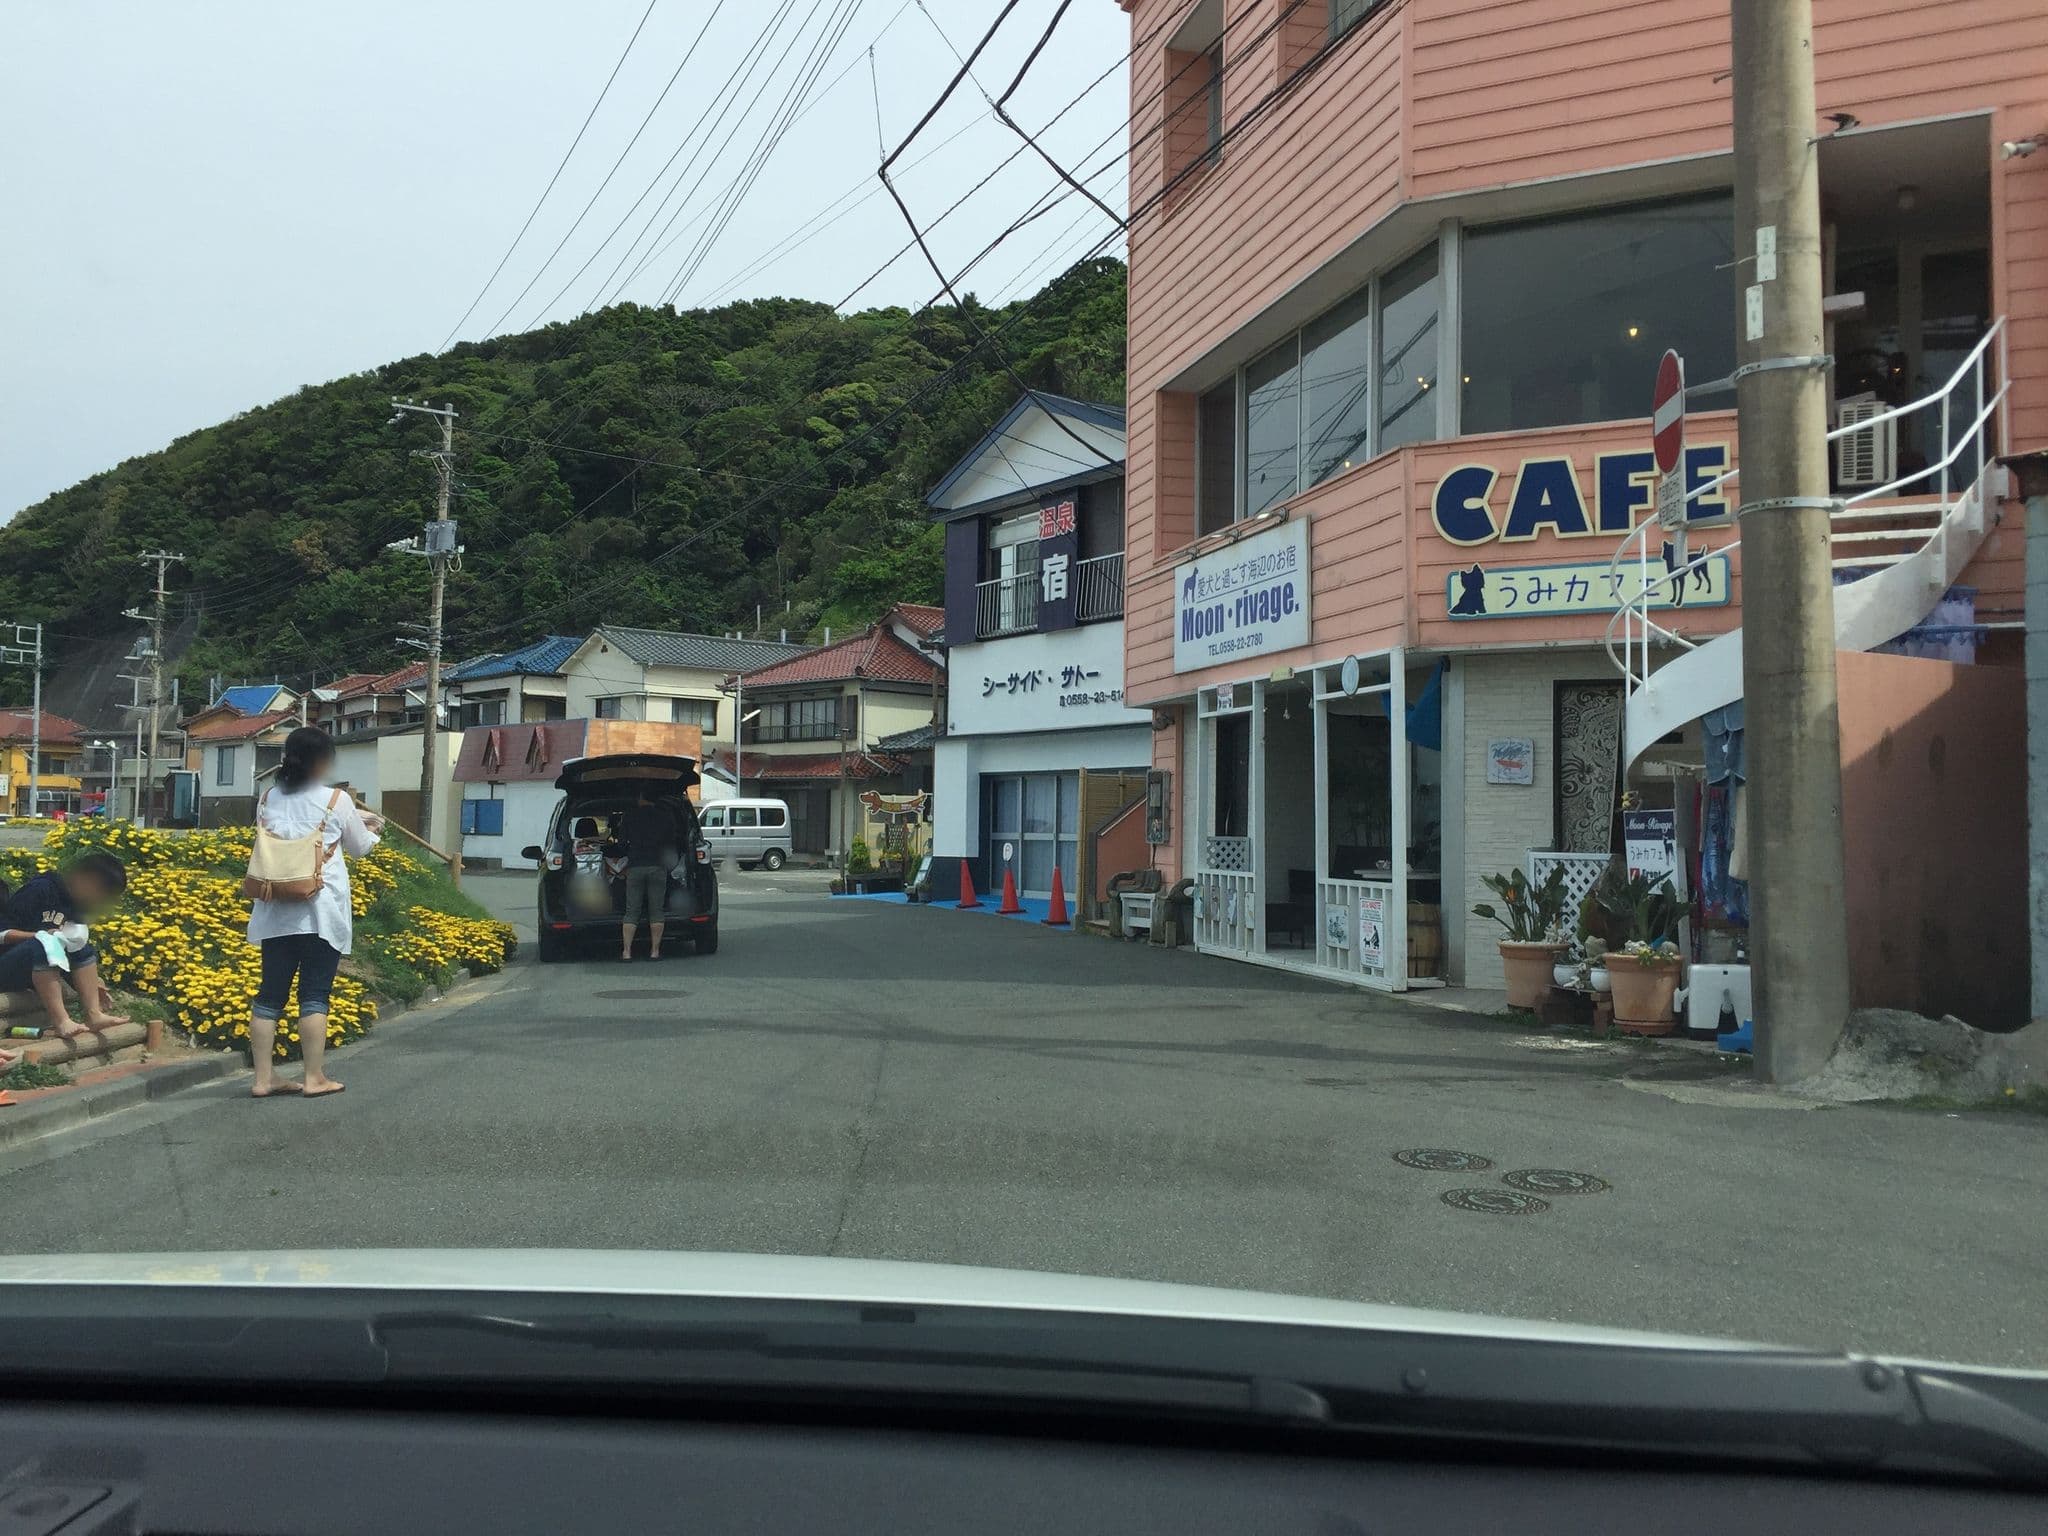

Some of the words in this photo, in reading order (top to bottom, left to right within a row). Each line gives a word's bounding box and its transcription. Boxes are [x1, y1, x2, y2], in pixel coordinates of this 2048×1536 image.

[1431, 441, 1731, 547] CAFE
[1040, 501, 1075, 540] 温泉
[1042, 553, 1069, 603] 宿
[1198, 545, 1296, 598] 愛犬と過ごす海辺のお宿
[1499, 573, 1661, 608] うみカフェ
